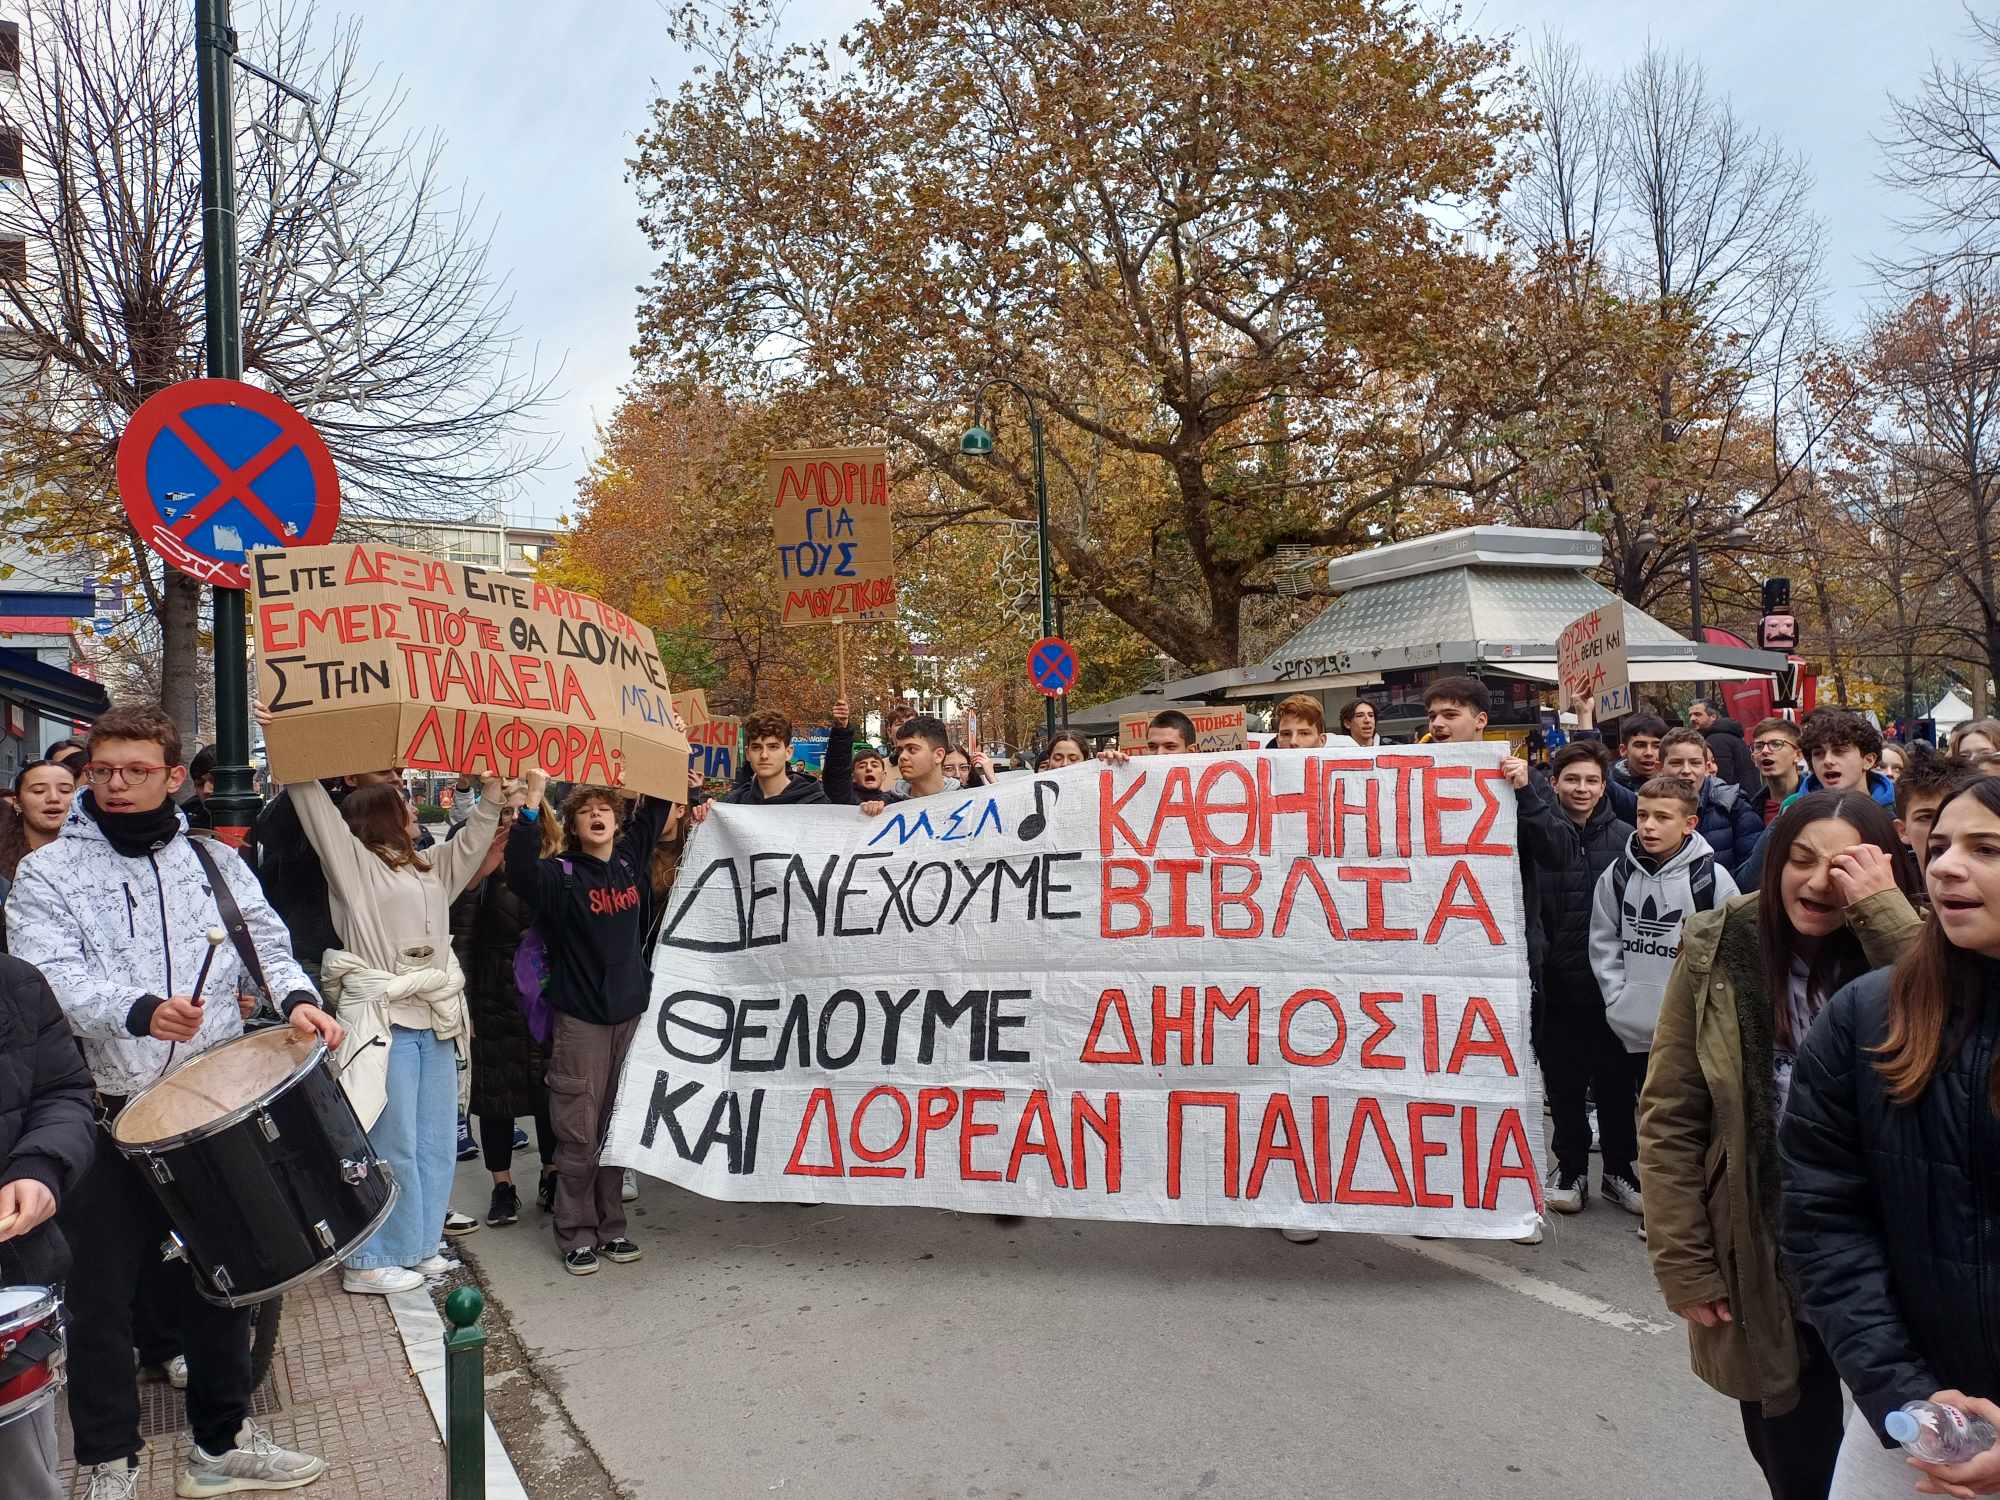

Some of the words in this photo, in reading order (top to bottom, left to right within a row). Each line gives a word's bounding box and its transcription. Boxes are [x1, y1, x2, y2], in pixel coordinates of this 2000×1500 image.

[775, 461, 887, 508] ΜΟΡΙΑ
[806, 507, 854, 541] ΓΙΑ
[255, 553, 338, 598] ΕΙΤΕ
[344, 544, 456, 596] ΔΕΞΙΑ
[463, 566, 530, 609] ΕΙΤΕ
[532, 583, 645, 648] ΑΡΙΣΤΕΡΑ
[777, 540, 858, 580] ΤΟΥΣ
[259, 602, 411, 653] ΕΜΕΙΣ
[509, 616, 548, 655] ΘΑ
[556, 618, 667, 691] ΔΟΥΜΕ
[264, 654, 392, 713] ΣΤΗΝ
[397, 641, 596, 721] ΠΑΙΔΕΙΑ
[1100, 755, 1514, 858] ΚΑΘΗΓΗΤΕΣ
[1100, 857, 1507, 947] ΒΙΒΛΙΑ
[1622, 938, 1678, 959] adidas
[656, 988, 1032, 1072] ΘΕΛΟΥΜΕ
[1079, 985, 1519, 1077] ΔΗΜΟΣΙΑ
[639, 1068, 766, 1176] ΚΑΙ
[1166, 1089, 1545, 1215] ΠΑΙΔΕΙΑ
